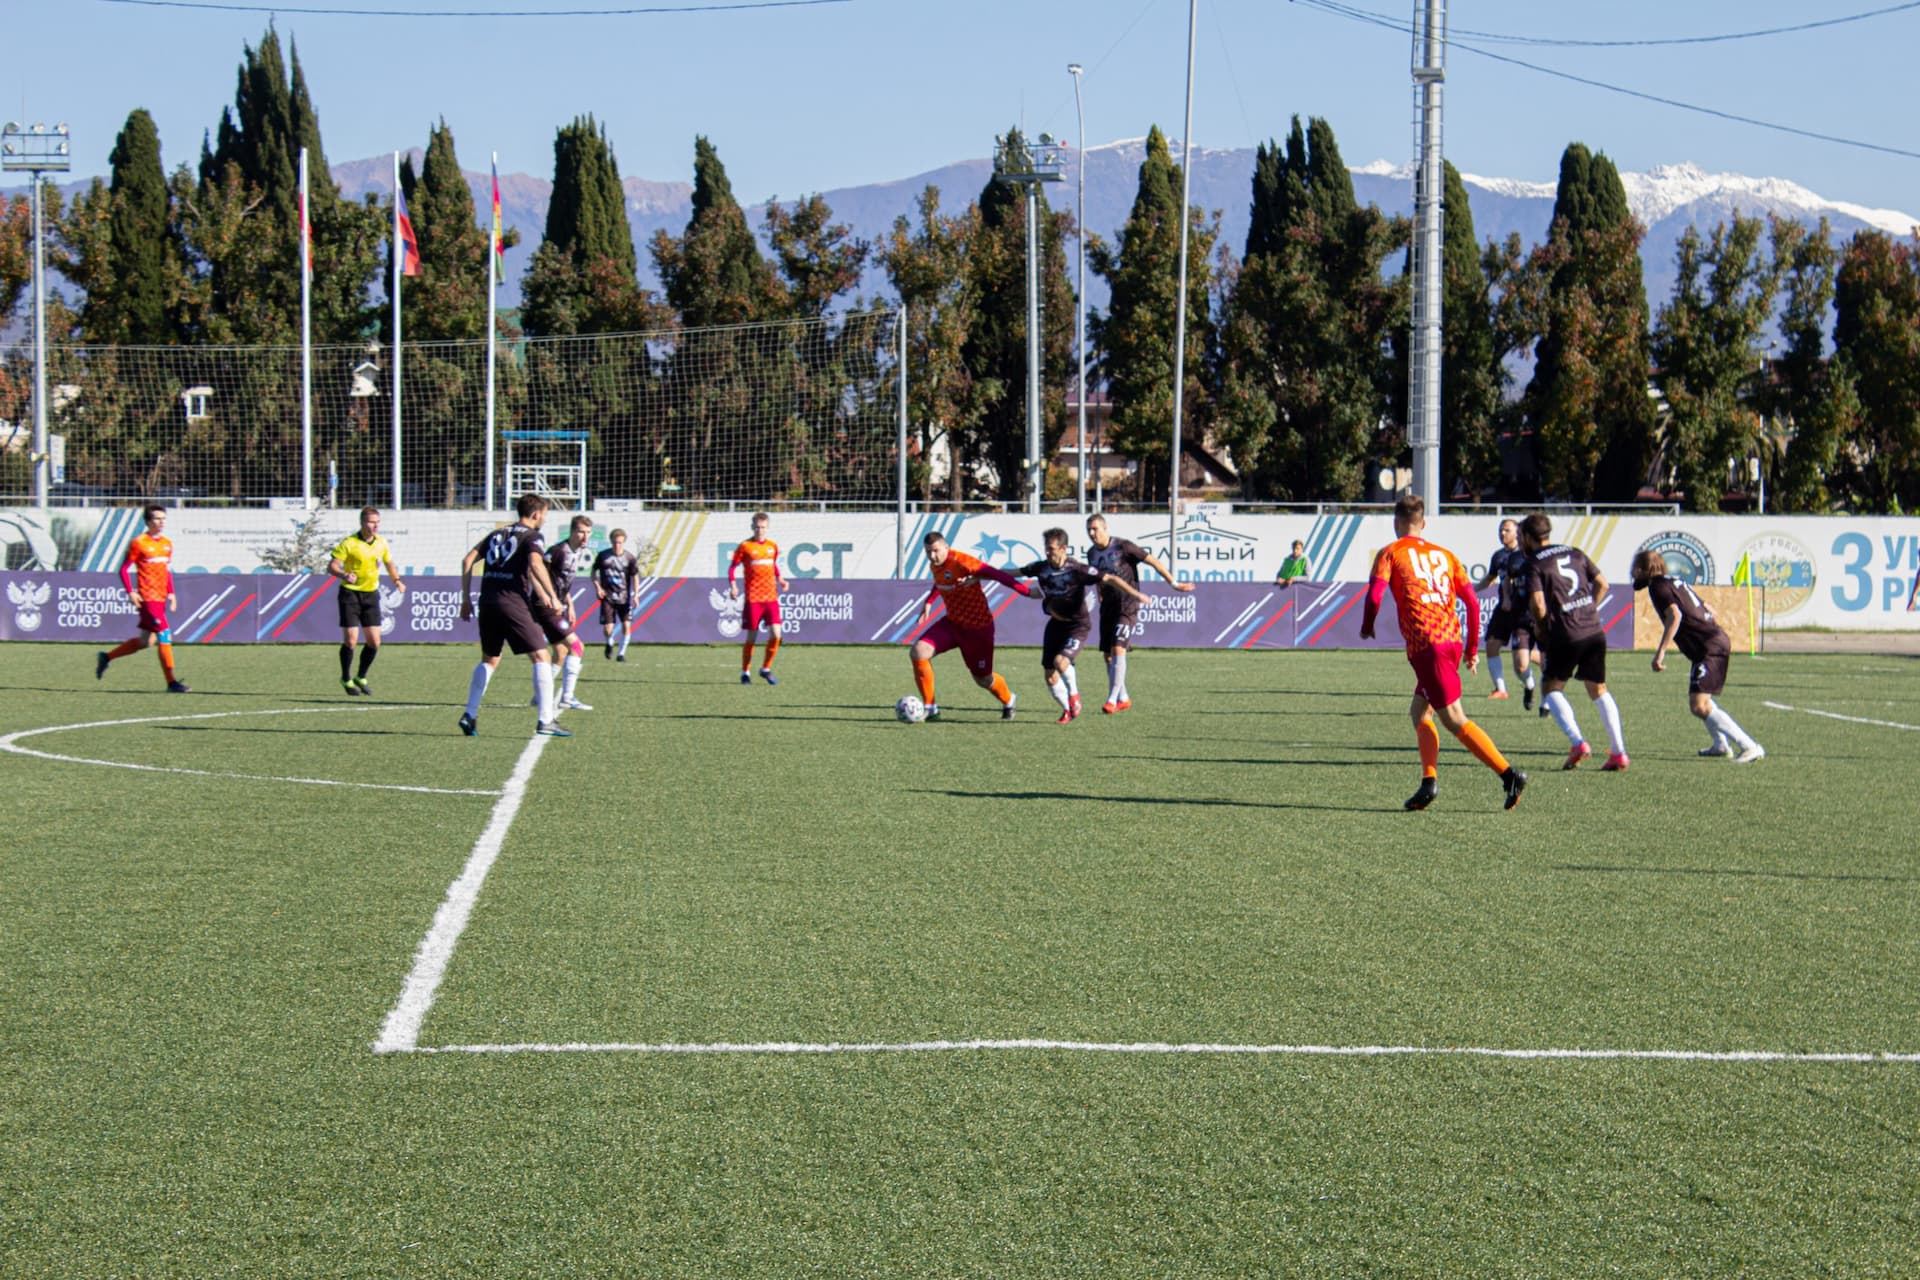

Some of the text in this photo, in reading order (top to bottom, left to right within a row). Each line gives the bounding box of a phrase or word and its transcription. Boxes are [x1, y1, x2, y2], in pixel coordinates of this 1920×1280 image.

[485, 533, 518, 567] 89
[717, 542, 853, 579] РСТ
[1408, 548, 1450, 597] 42
[1557, 555, 1579, 597] 5
[1831, 532, 1873, 612] 3
[57, 586, 131, 601] РОССИЙС
[778, 592, 853, 607] ССИЙСКИЙ
[57, 614, 102, 628] СОЮЗ
[411, 617, 454, 631] СОЮЗ
[1137, 609, 1196, 623] ОЛЬНЫЙ
